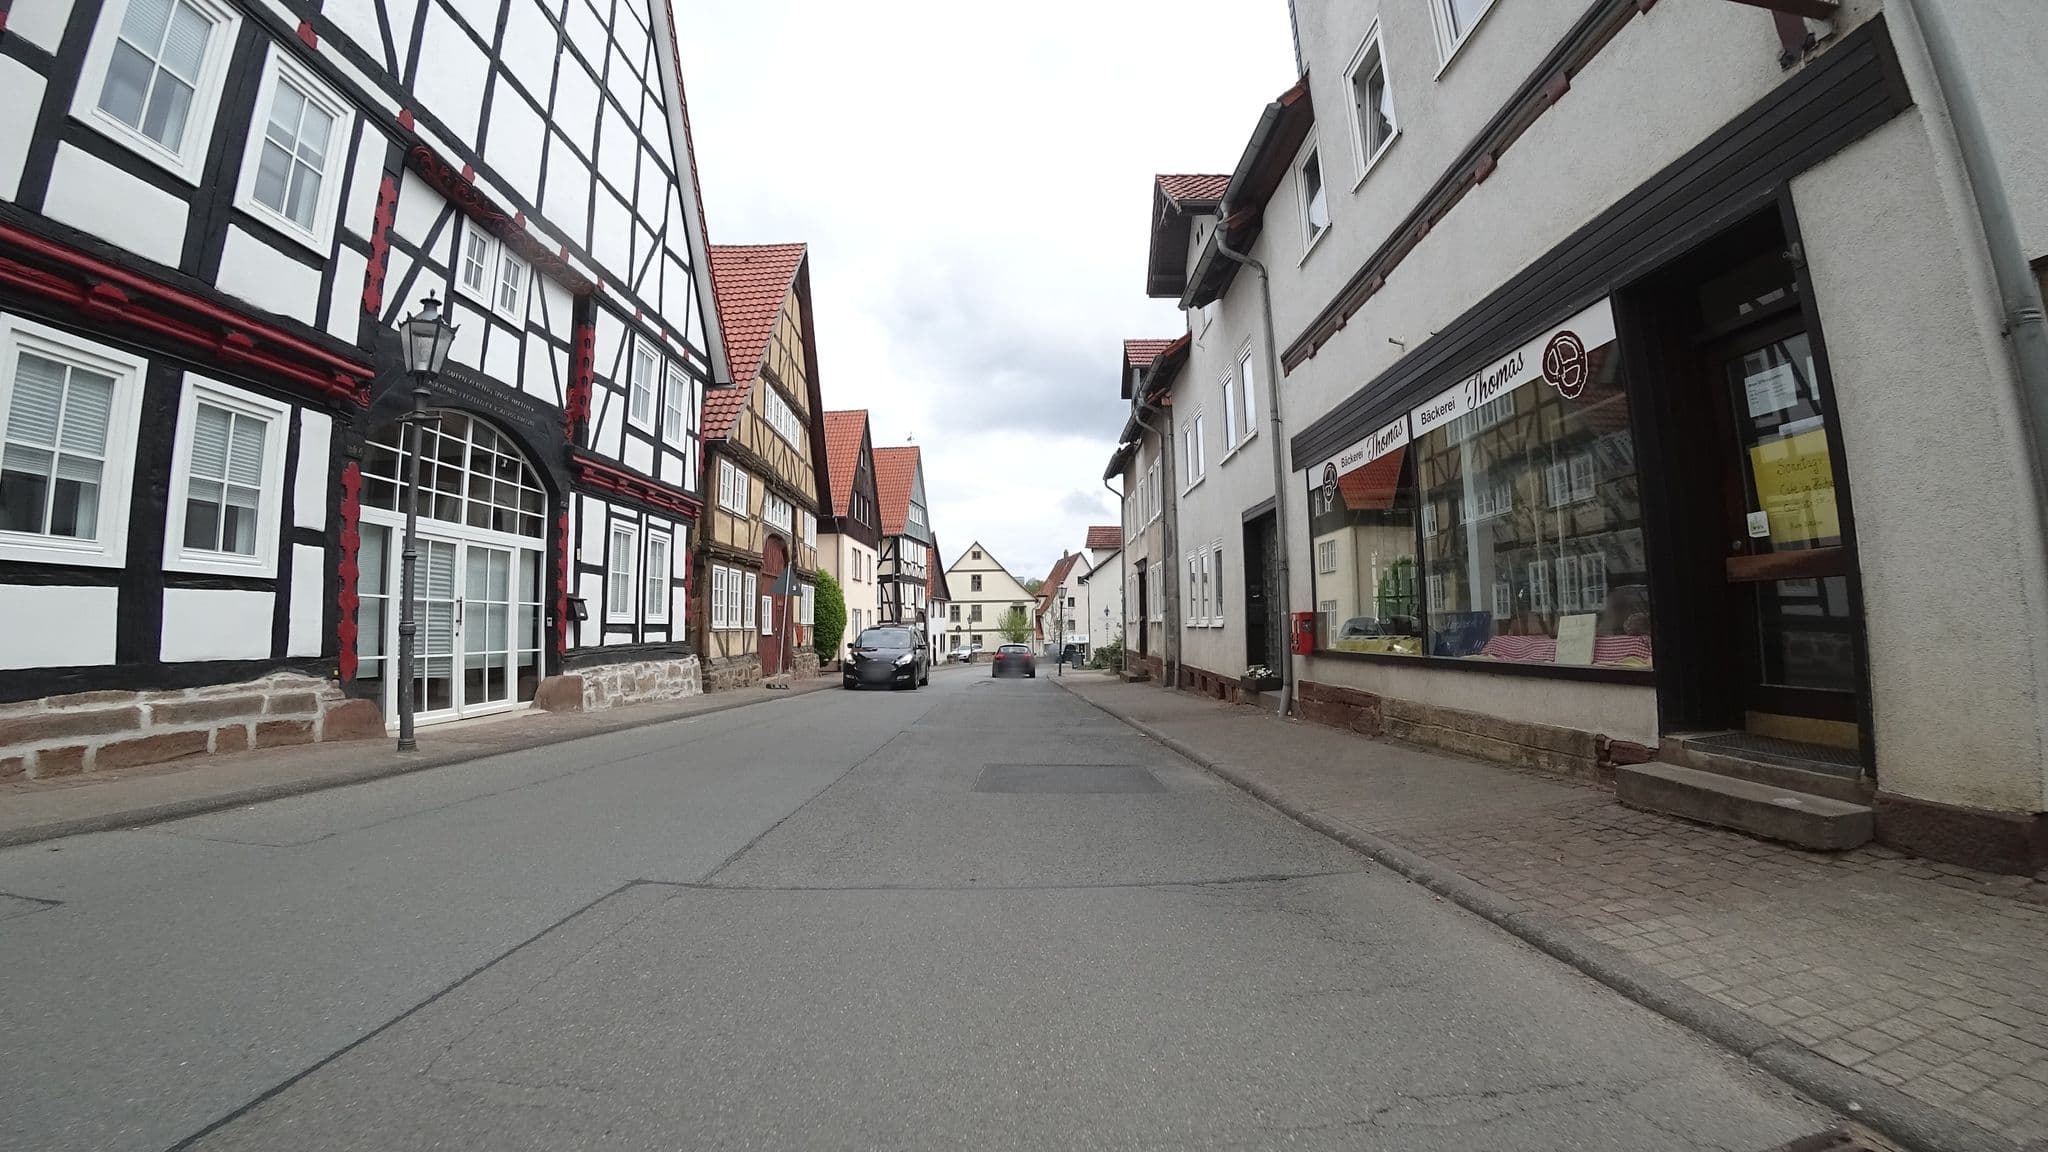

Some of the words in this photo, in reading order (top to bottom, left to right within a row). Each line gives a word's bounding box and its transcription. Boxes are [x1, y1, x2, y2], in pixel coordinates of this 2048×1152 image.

[1420, 396, 1456, 425] Bäckerei
[1465, 352, 1526, 410] Thomas
[1341, 448, 1364, 469] Bäckerei
[1366, 420, 1404, 462] Thomas
